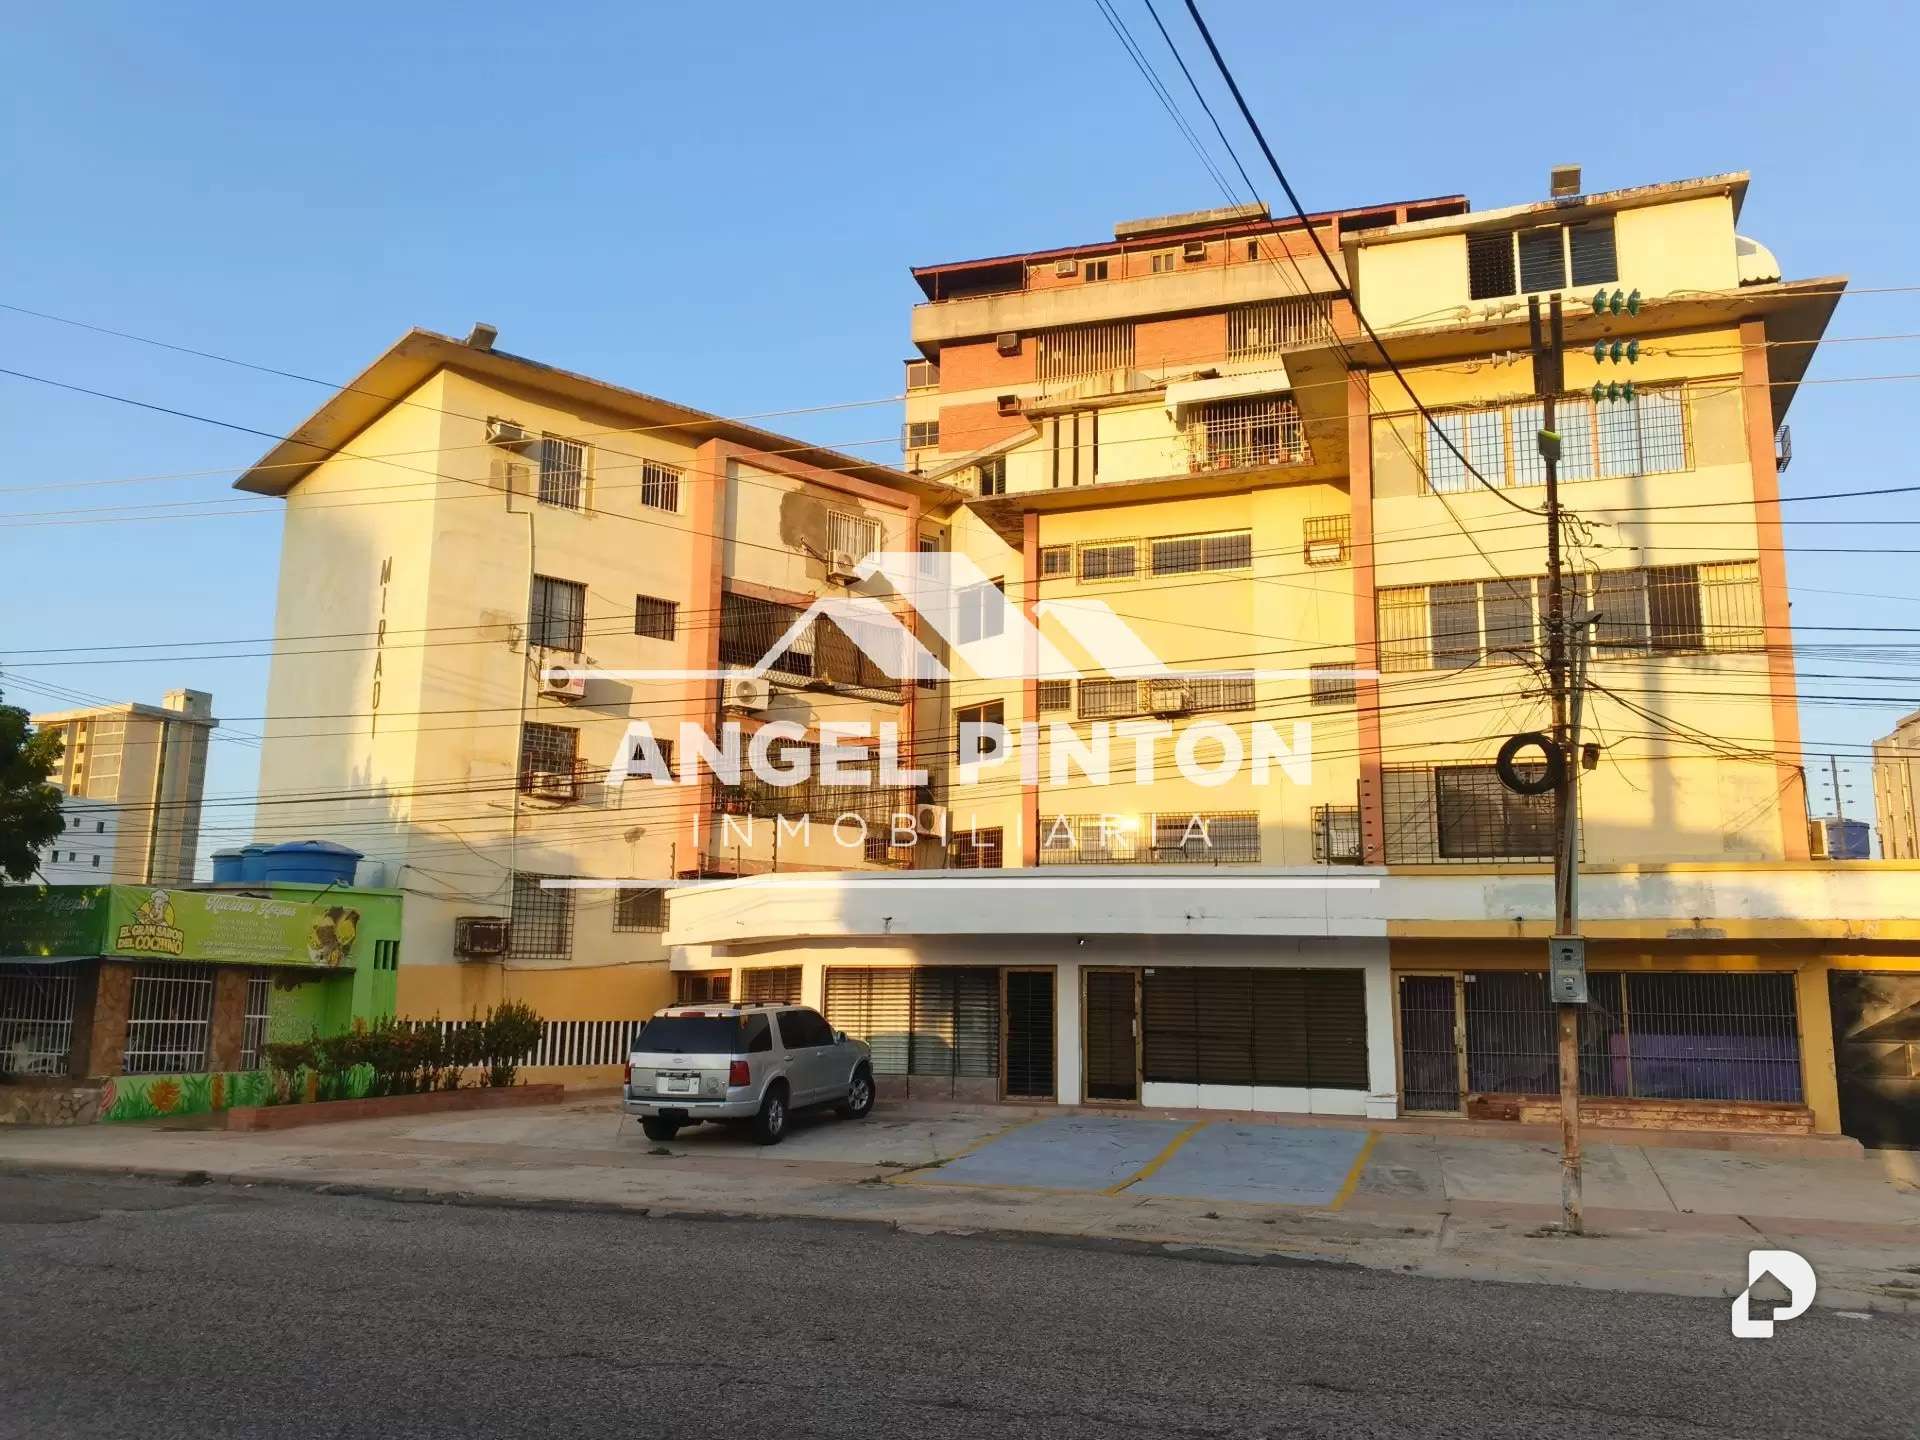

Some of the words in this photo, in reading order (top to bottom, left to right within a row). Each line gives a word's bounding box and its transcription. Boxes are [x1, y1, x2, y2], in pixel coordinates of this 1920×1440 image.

[131, 924, 156, 937] GRAN
[117, 938, 135, 949] DEL
[135, 935, 183, 954] COCHINO
